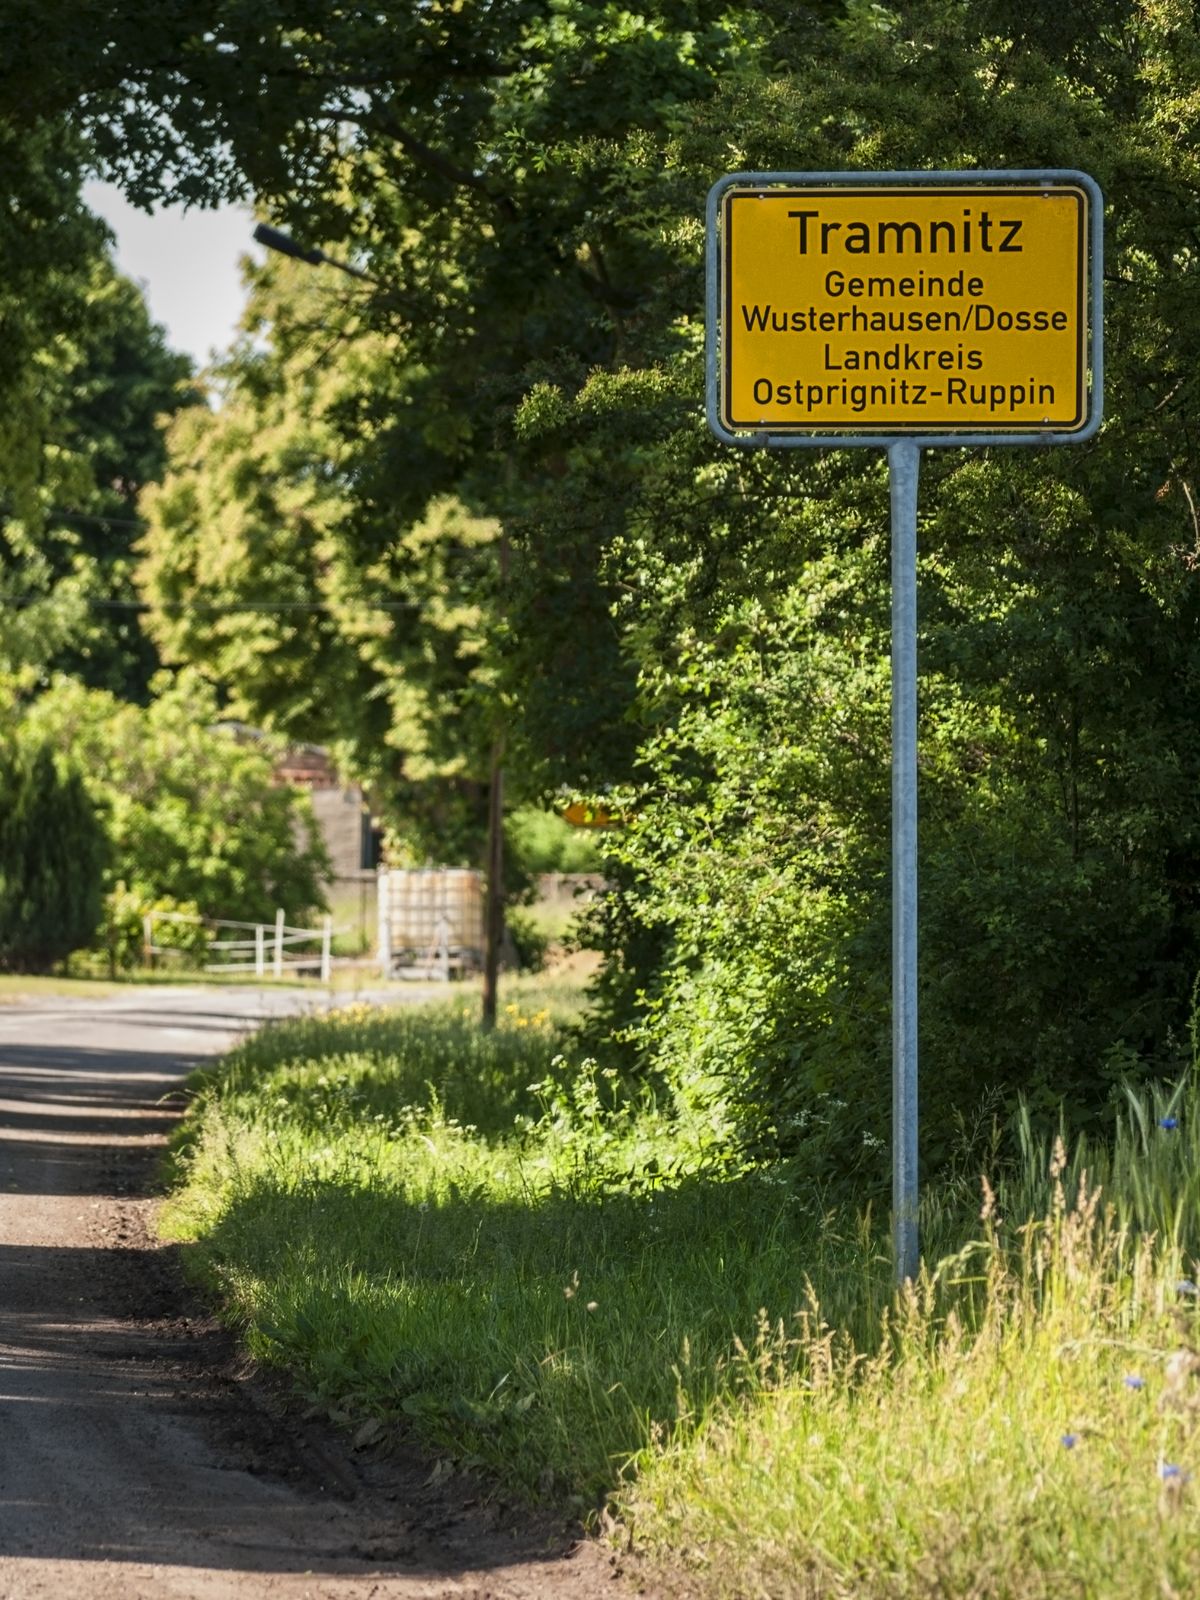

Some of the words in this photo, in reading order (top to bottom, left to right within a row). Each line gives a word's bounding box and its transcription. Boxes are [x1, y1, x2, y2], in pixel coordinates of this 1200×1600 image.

[788, 209, 1023, 255] Tramnitz
[824, 270, 984, 297] Gemeinde
[741, 304, 1068, 332] Wusterhausen/Dosse
[824, 343, 983, 370] Landkreis
[753, 377, 1055, 412] Ostprignitz-Ruppin
